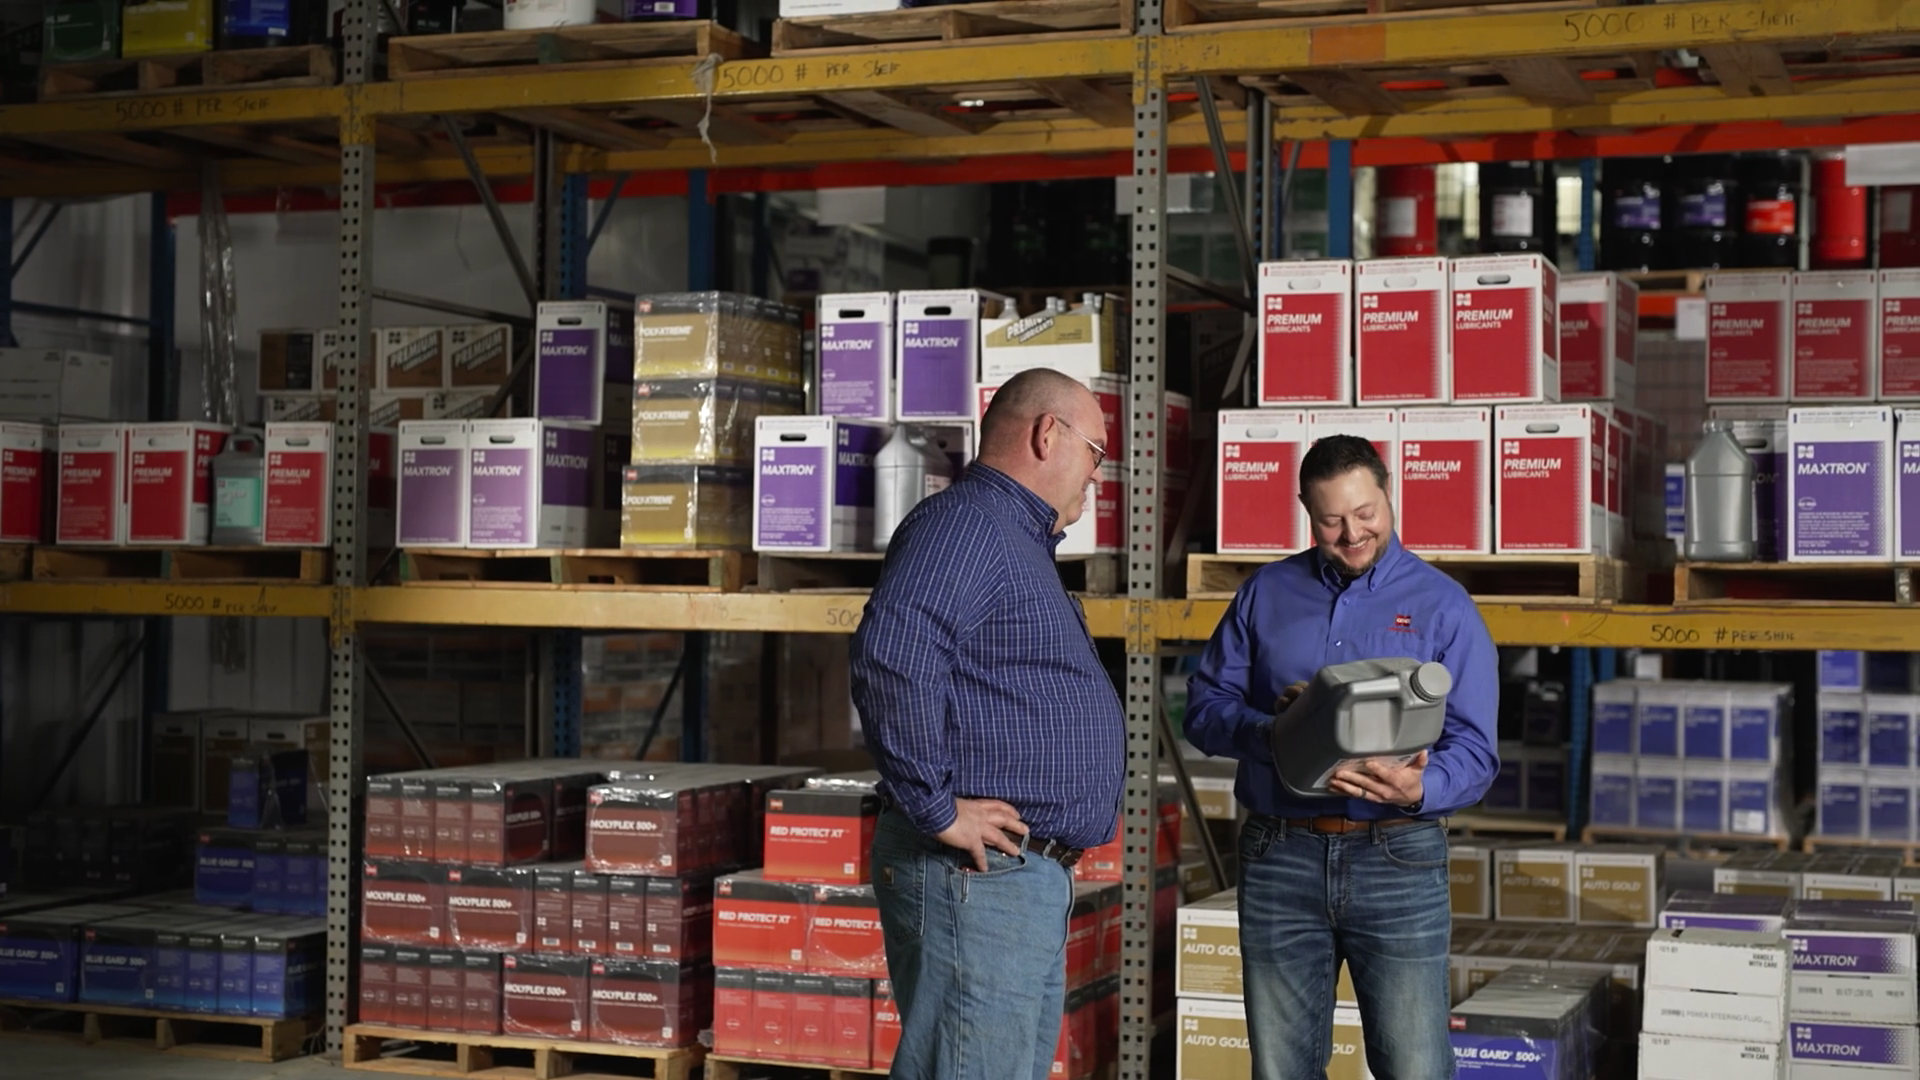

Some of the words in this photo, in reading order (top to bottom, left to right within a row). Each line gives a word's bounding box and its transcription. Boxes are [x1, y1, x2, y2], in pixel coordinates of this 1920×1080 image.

[1563, 12, 1643, 41] 5000
[1664, 14, 1676, 28] #
[723, 65, 784, 88] 5000
[795, 64, 807, 78] #
[116, 101, 166, 121] 5000
[1267, 312, 1322, 325] PREMIUM
[1362, 310, 1418, 323] PREMIUM
[1456, 308, 1513, 321] PREMIUM
[1712, 318, 1764, 330] PREMIUM
[1797, 318, 1851, 329] PREMIUM
[822, 340, 873, 350] MAXTRON
[905, 337, 959, 348] MAXTRON
[545, 453, 588, 469] MAXTRON
[1225, 461, 1279, 473] PREMIUM
[1405, 460, 1462, 473] PREMIUM
[1504, 458, 1561, 471] PREMIUM
[473, 466, 521, 477] MAXTRON
[762, 464, 814, 475] MAXTRON
[1798, 463, 1867, 475] MAXTRON
[165, 592, 204, 610] 5000
[1651, 624, 1700, 643] 5000
[1714, 627, 1728, 641] #
[590, 820, 634, 829] MOLYPLEX
[769, 826, 788, 836] RED
[790, 826, 830, 838] PROTECT
[831, 829, 844, 838] XT
[1582, 881, 1610, 890] AUTO
[1612, 881, 1641, 892] GOLD
[365, 890, 406, 902] MOLYPLEX
[449, 896, 491, 907] MOLYPLEX
[718, 911, 736, 920] RED
[738, 912, 778, 923] PROTECT
[814, 917, 832, 927] RED
[835, 919, 874, 930] PROTECT
[1184, 943, 1215, 954] AUTO
[1217, 945, 1242, 956] GOL
[1793, 954, 1857, 967] MAXTRON
[505, 983, 545, 995] MOLYPLEX
[592, 989, 635, 1001] MOLYPLEX
[876, 1012, 894, 1022] RED
[1184, 1035, 1217, 1046] AUTO
[1332, 1044, 1355, 1055] OLD
[1795, 1042, 1861, 1056] MAXTRON
[1479, 1049, 1511, 1060] GARD
[1515, 1051, 1542, 1062] 500+
